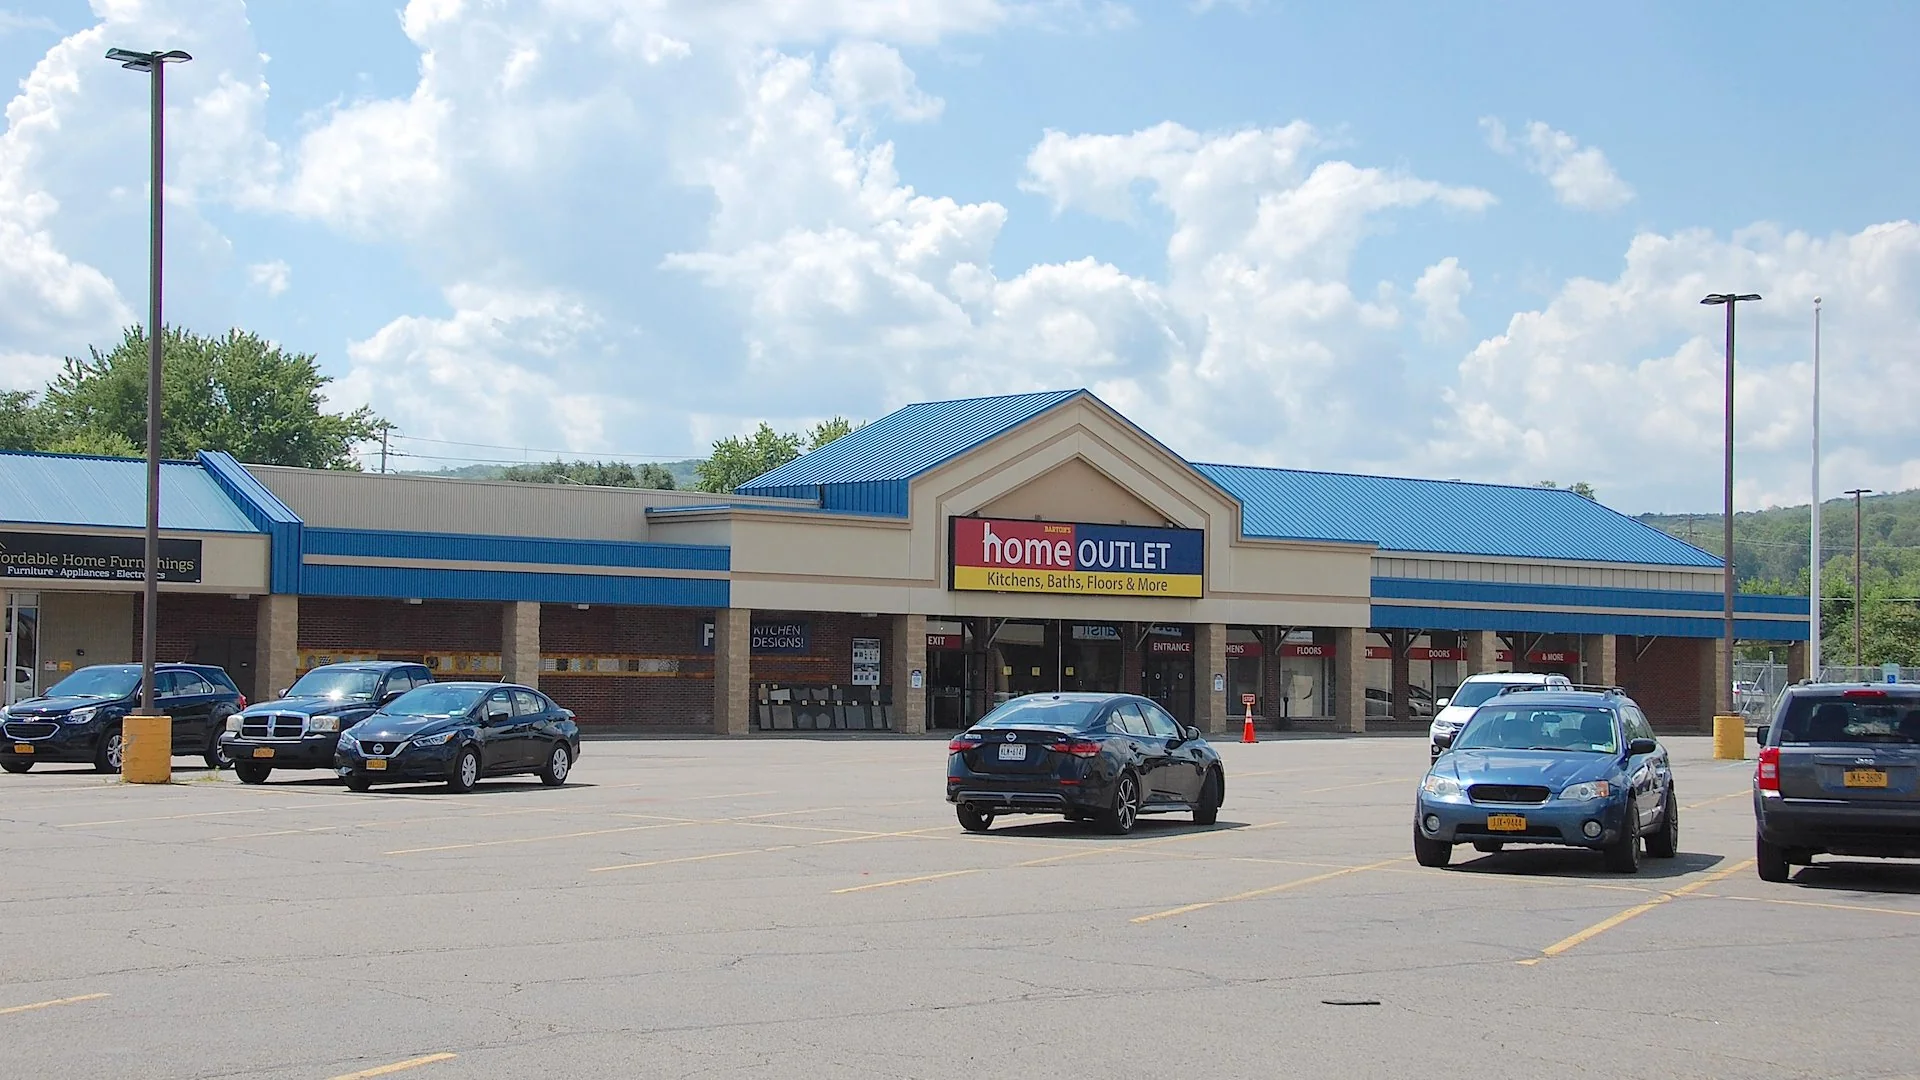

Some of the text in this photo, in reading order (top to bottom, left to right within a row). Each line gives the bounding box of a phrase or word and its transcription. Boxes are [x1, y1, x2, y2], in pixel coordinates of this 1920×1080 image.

[982, 522, 1171, 569] home OUTLET
[62, 553, 106, 567] Home
[110, 555, 195, 573] Furnhings
[7, 566, 54, 576] Furniture
[60, 567, 110, 578] Appliances
[987, 572, 1168, 591] Kitchens, Baths, Floors & More
[753, 624, 801, 636] KITCHEN
[752, 637, 804, 648] DESIGNS!
[928, 636, 945, 645] EXIT
[1153, 642, 1190, 651] ENTRANCE
[1296, 646, 1322, 655] FLOORS
[1429, 649, 1450, 658] DOORS
[1547, 653, 1564, 661] MORE
